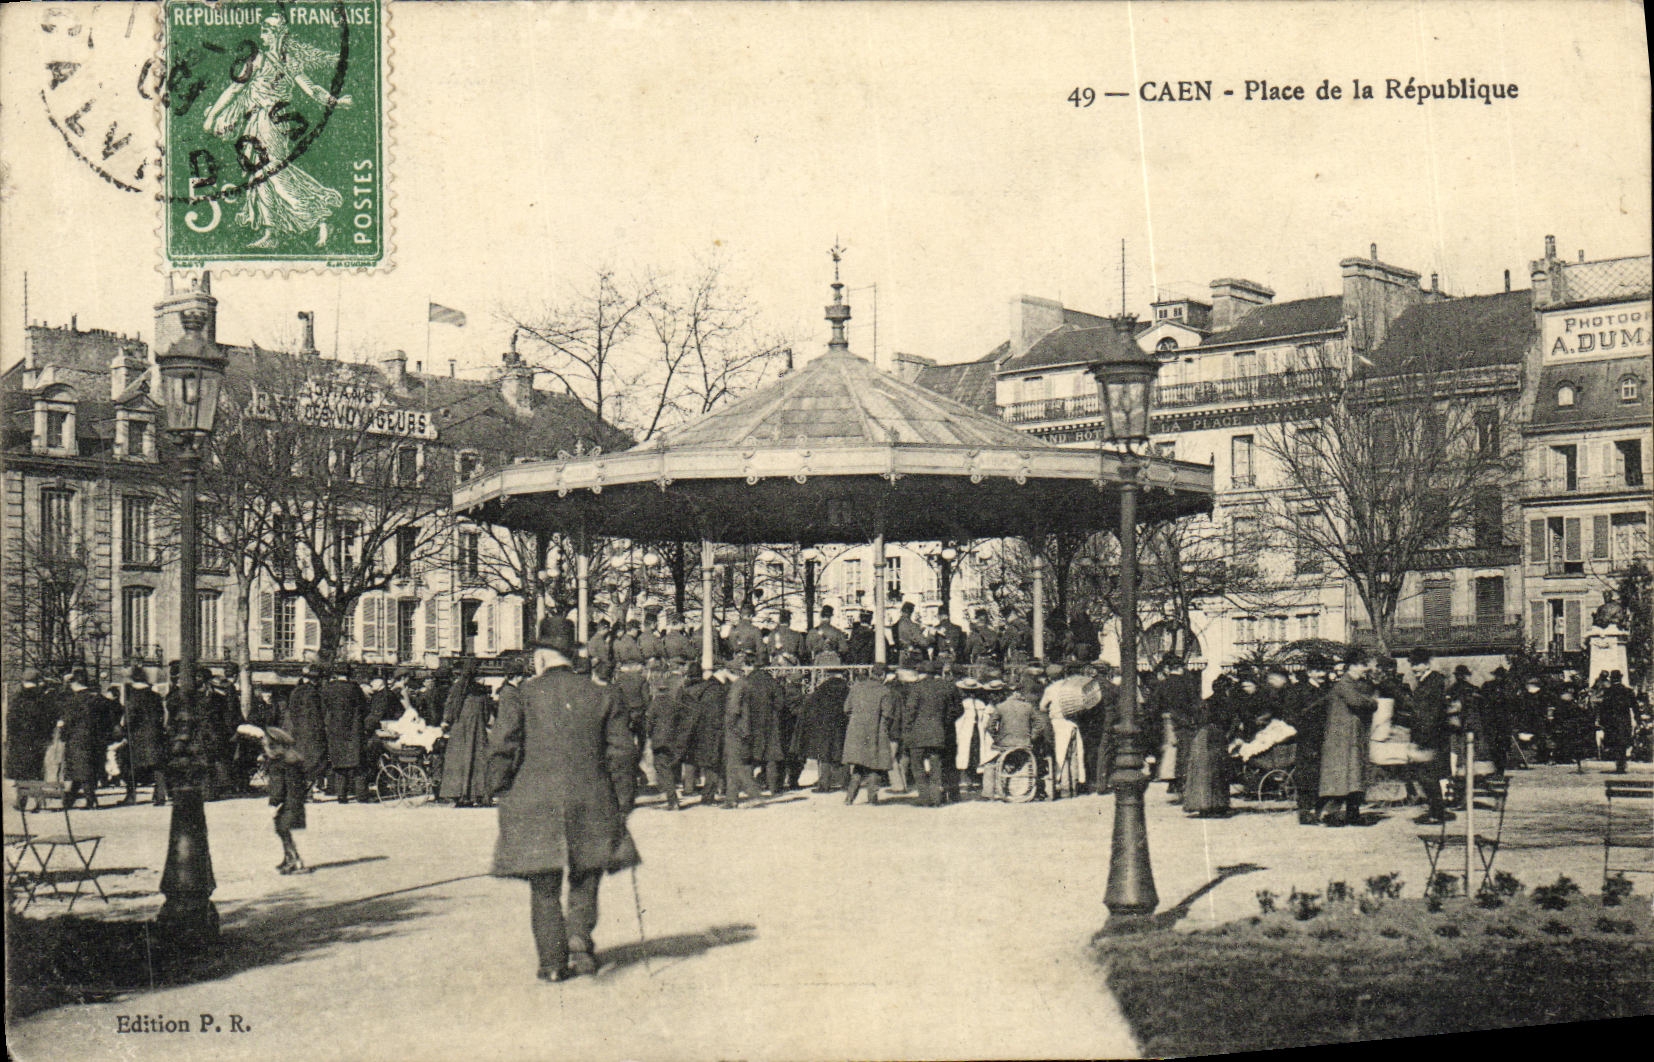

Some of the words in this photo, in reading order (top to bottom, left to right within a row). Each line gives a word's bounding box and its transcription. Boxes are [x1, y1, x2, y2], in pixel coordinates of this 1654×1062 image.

[353, 158, 374, 246] POSTES
[1564, 312, 1652, 332] PHOTOG
[333, 403, 428, 436] VOYAGEURS
[1161, 422, 1181, 433] LA
[1192, 415, 1242, 430] PLACE
